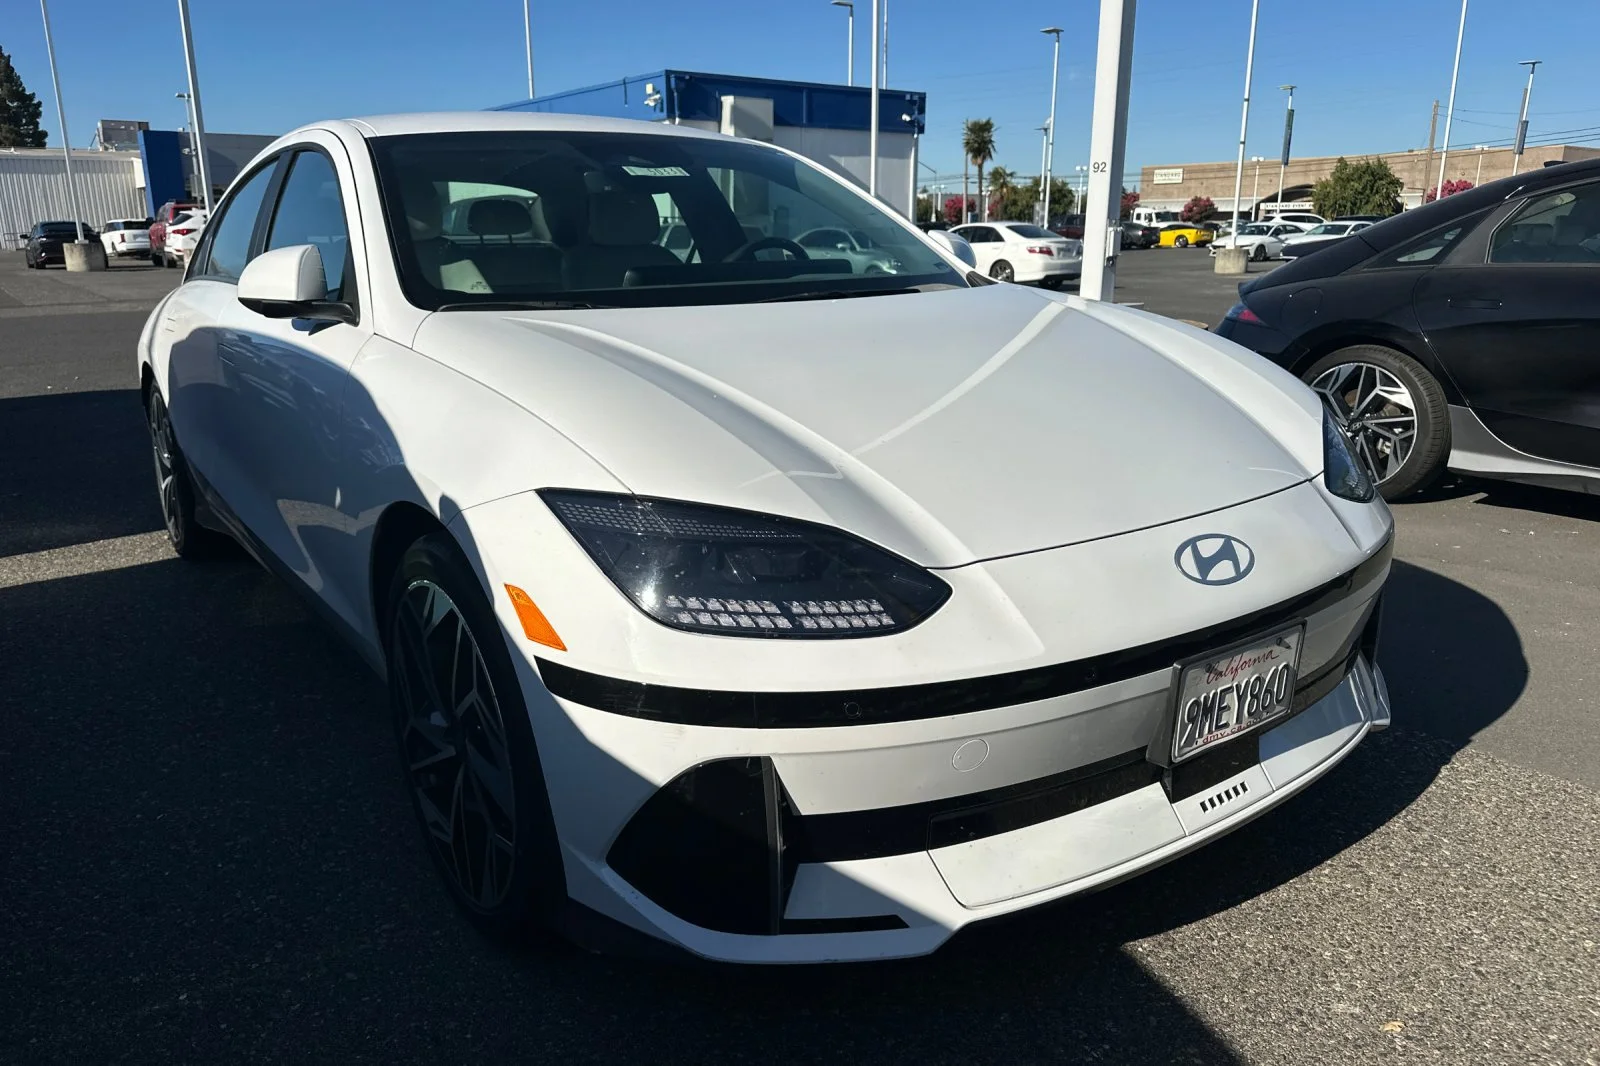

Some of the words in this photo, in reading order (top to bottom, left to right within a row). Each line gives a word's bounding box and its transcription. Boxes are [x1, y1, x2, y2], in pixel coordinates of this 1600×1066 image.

[1093, 161, 1107, 173] 92
[1206, 649, 1280, 685] California
[1180, 661, 1289, 747] 9MEY860
